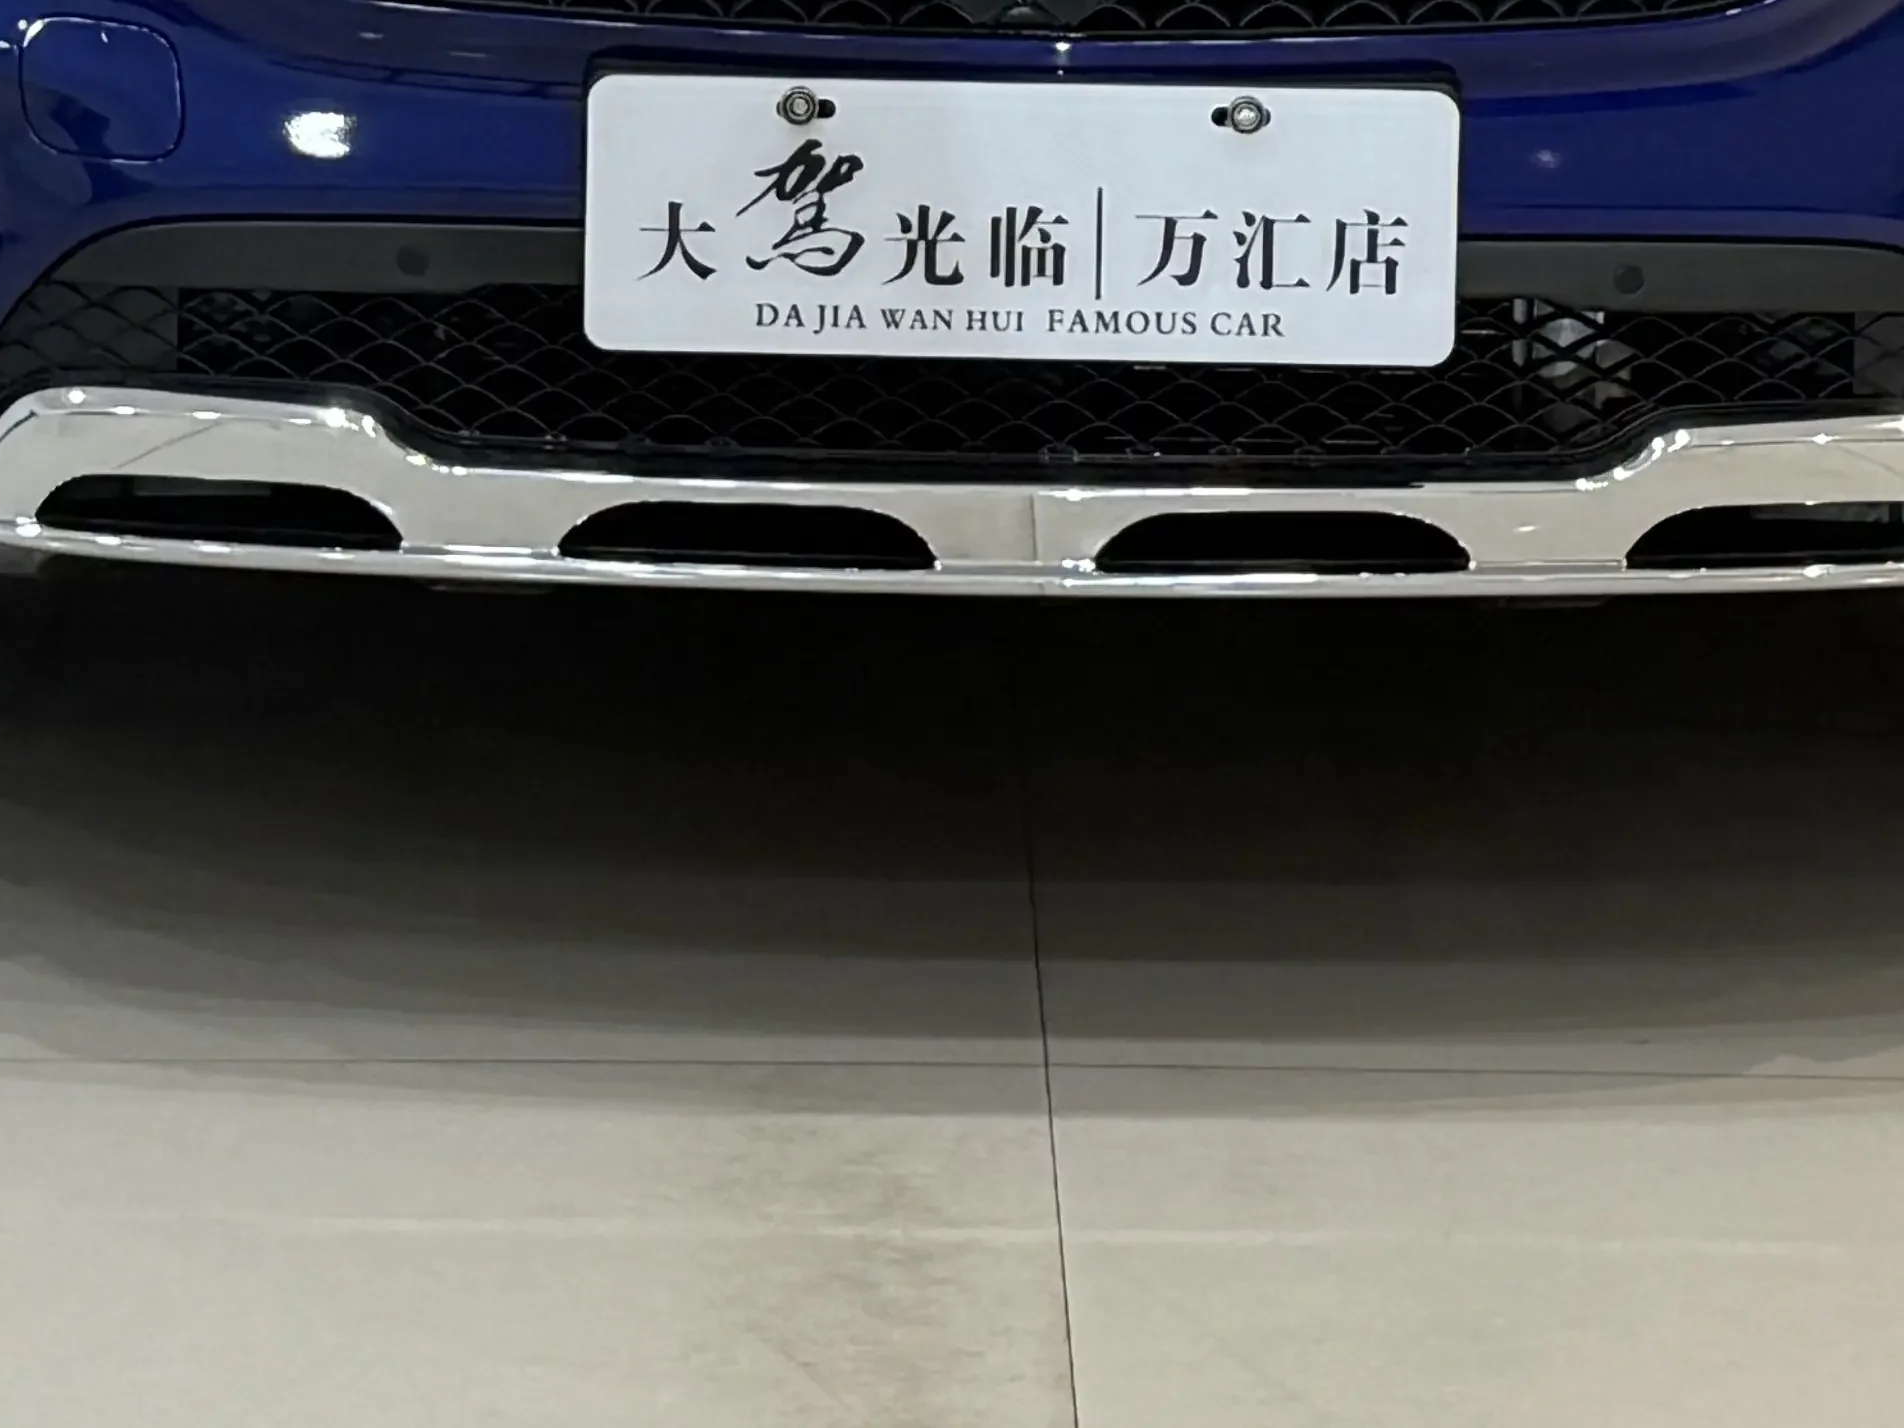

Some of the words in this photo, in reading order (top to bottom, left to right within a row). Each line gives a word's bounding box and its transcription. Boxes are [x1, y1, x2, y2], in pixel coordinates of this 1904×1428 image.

[1135, 209, 1409, 295] 万汇店
[755, 302, 806, 329] DA
[812, 303, 868, 334] JIA
[880, 308, 954, 332] WAN
[966, 309, 1025, 332] HUI
[1047, 309, 1198, 336] FAMOUS
[1210, 311, 1286, 338] CAR
